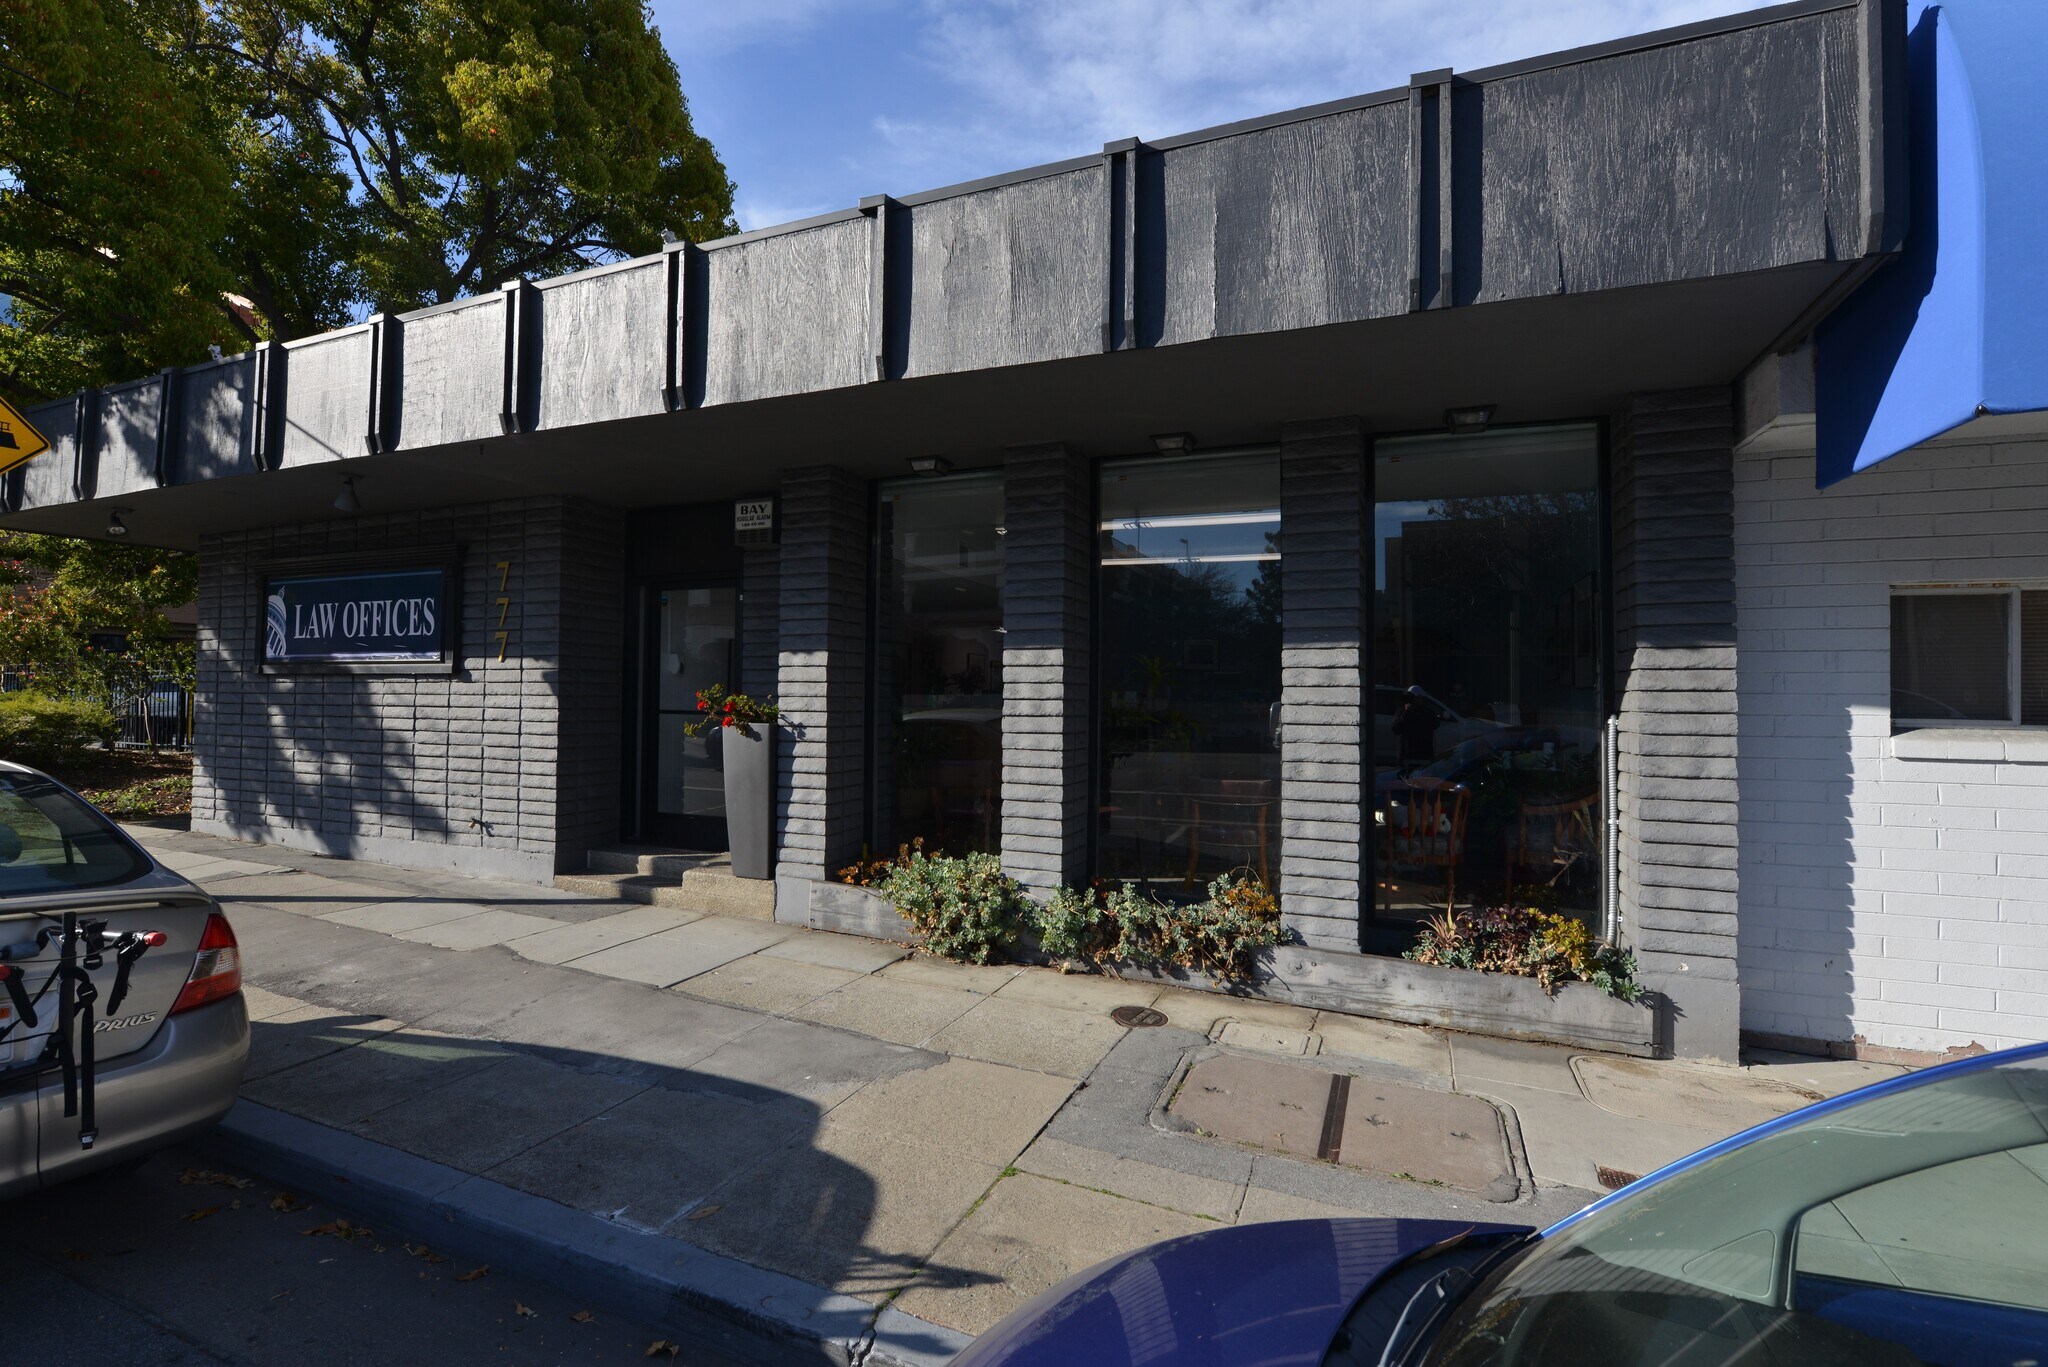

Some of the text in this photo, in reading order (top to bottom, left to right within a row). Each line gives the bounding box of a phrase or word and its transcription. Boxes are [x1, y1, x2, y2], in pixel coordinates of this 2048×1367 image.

[740, 504, 768, 515] BAY
[293, 597, 435, 639] LAW OFFICES
[494, 561, 511, 662] 777
[93, 1010, 158, 1034] PRIUS
